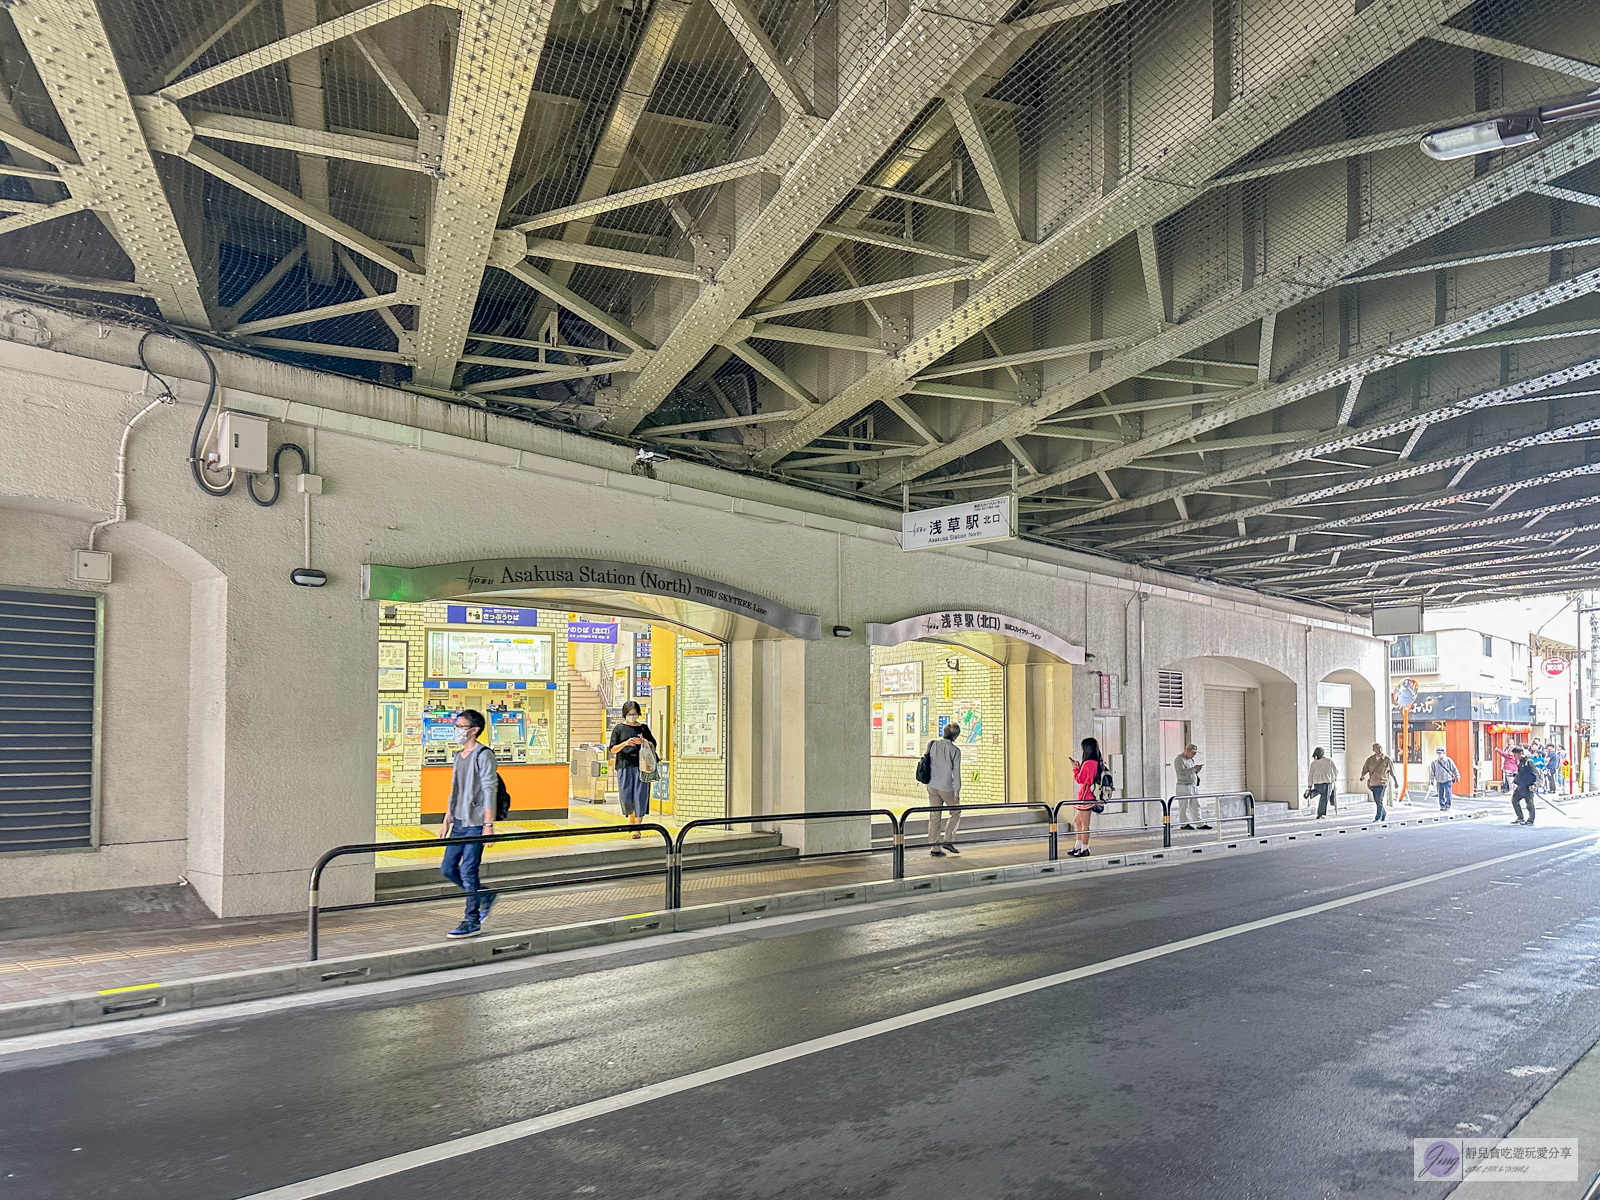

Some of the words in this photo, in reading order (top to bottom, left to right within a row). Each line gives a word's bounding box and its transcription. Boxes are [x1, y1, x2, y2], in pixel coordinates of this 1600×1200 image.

[929, 514, 979, 536] 浅草駅
[983, 514, 1000, 524] 北口
[500, 565, 574, 584] Asakusa
[579, 566, 635, 586] Station
[640, 570, 692, 596] (North)
[696, 586, 717, 599] TOBU
[718, 592, 752, 610] SKYTREE
[753, 604, 768, 615] Line
